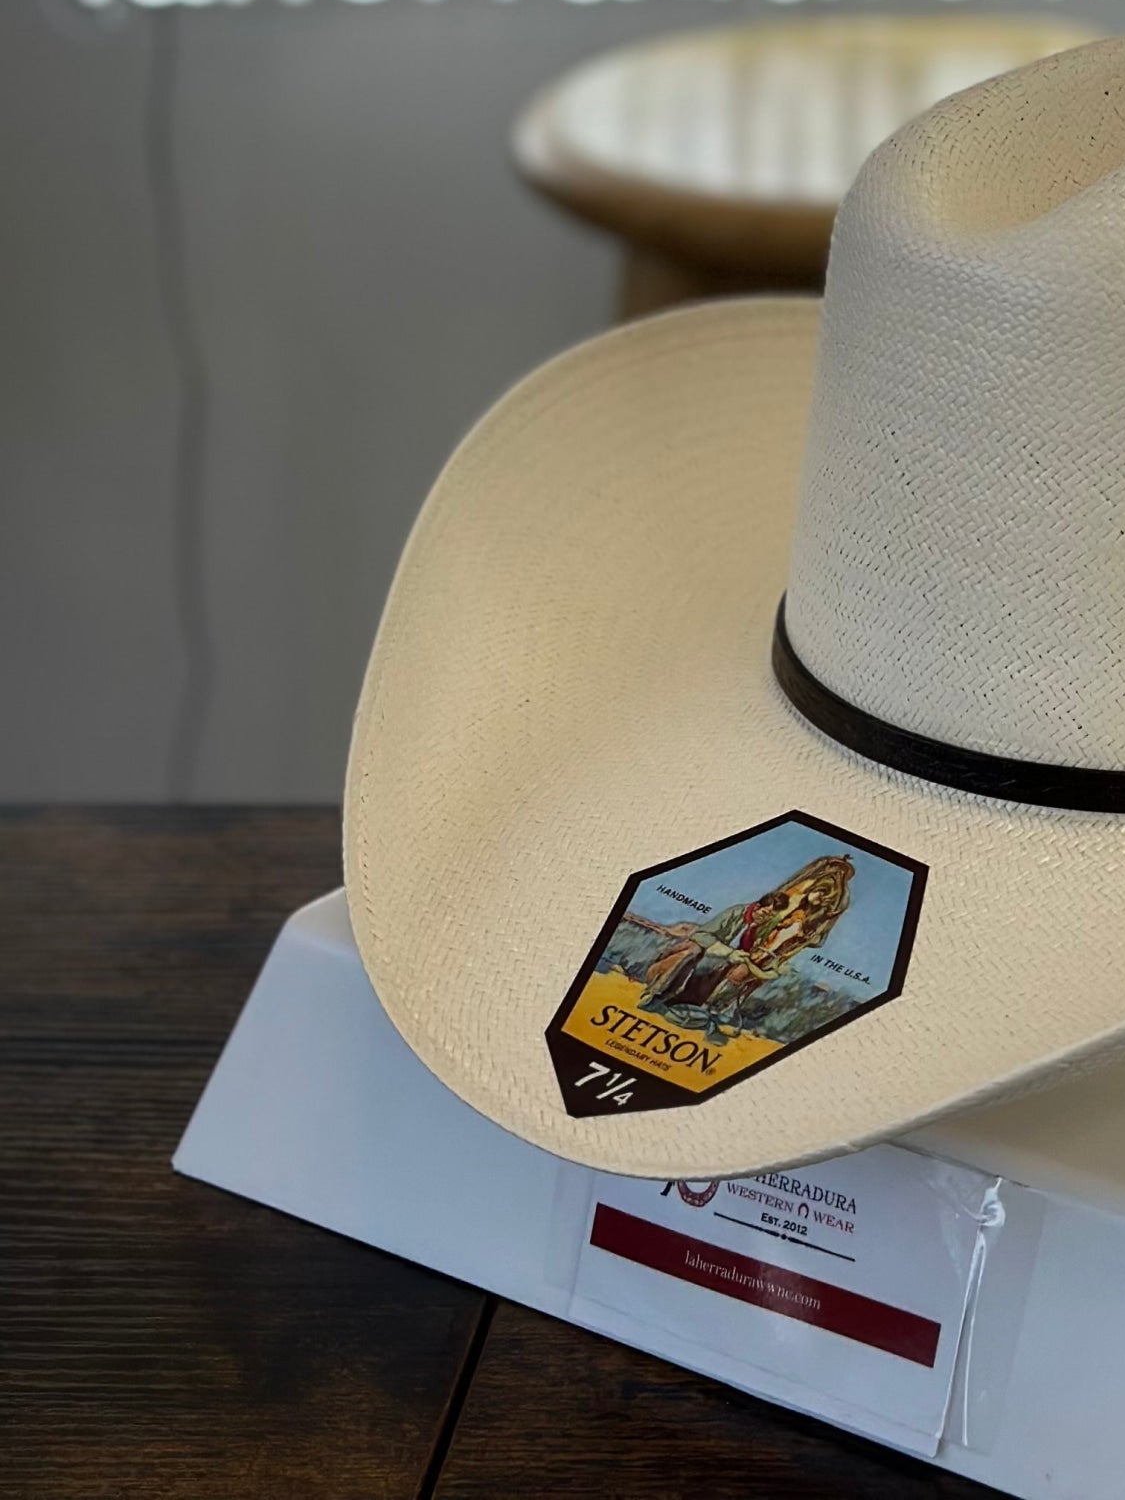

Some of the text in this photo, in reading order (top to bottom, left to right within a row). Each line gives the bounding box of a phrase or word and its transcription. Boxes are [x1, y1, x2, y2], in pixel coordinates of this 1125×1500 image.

[656, 884, 713, 914] HANDMADE
[810, 954, 872, 985] IN THE U.S.A.
[650, 1059, 672, 1072] HATS
[727, 1182, 855, 1234] WESTERN WEAR
[783, 1219, 809, 1236] 2012
[684, 1250, 821, 1310] laherradurawwnc.com
